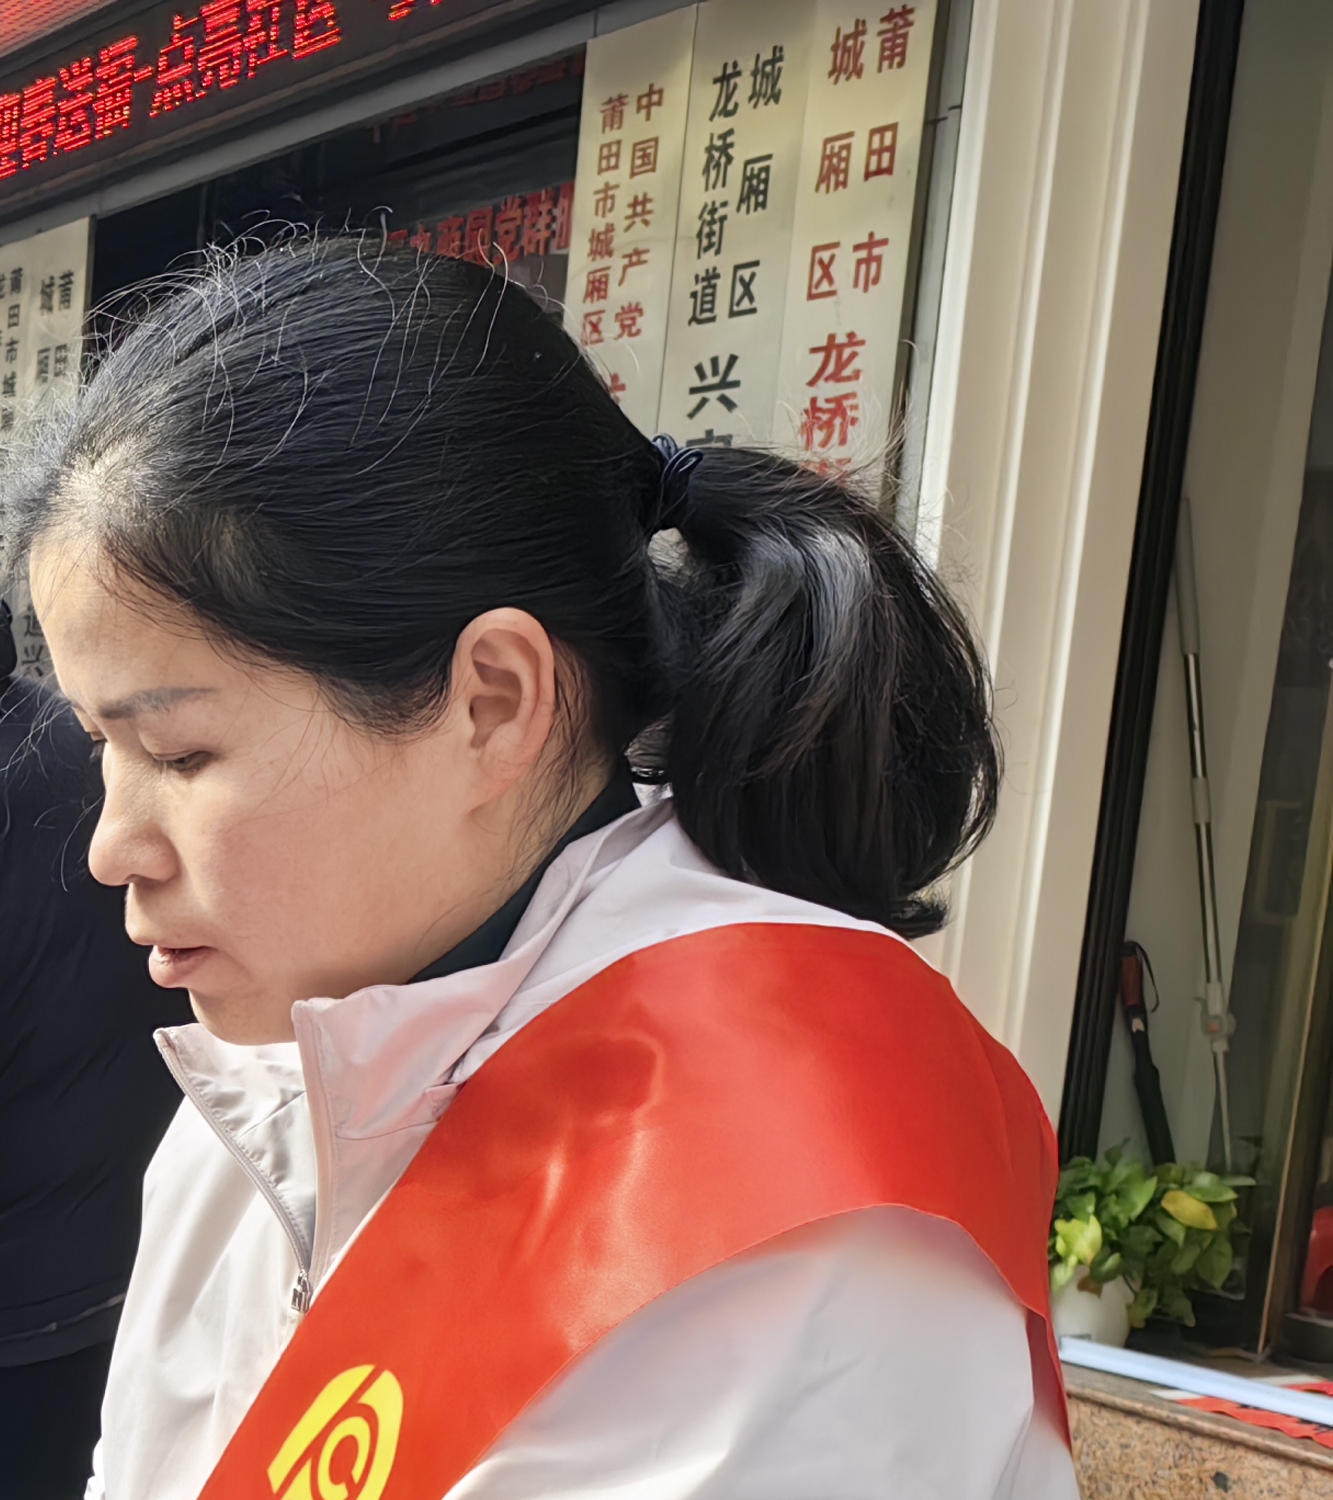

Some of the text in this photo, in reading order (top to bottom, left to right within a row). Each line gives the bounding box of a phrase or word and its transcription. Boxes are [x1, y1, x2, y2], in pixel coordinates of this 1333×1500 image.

[581, 93, 630, 346] 莆田市城厢区
[615, 83, 665, 341] 中国共产党
[687, 61, 743, 326] 龙桥街道
[728, 45, 785, 319] 城厢区
[806, 19, 865, 301] 城厢区
[851, 5, 915, 294] 莆田市
